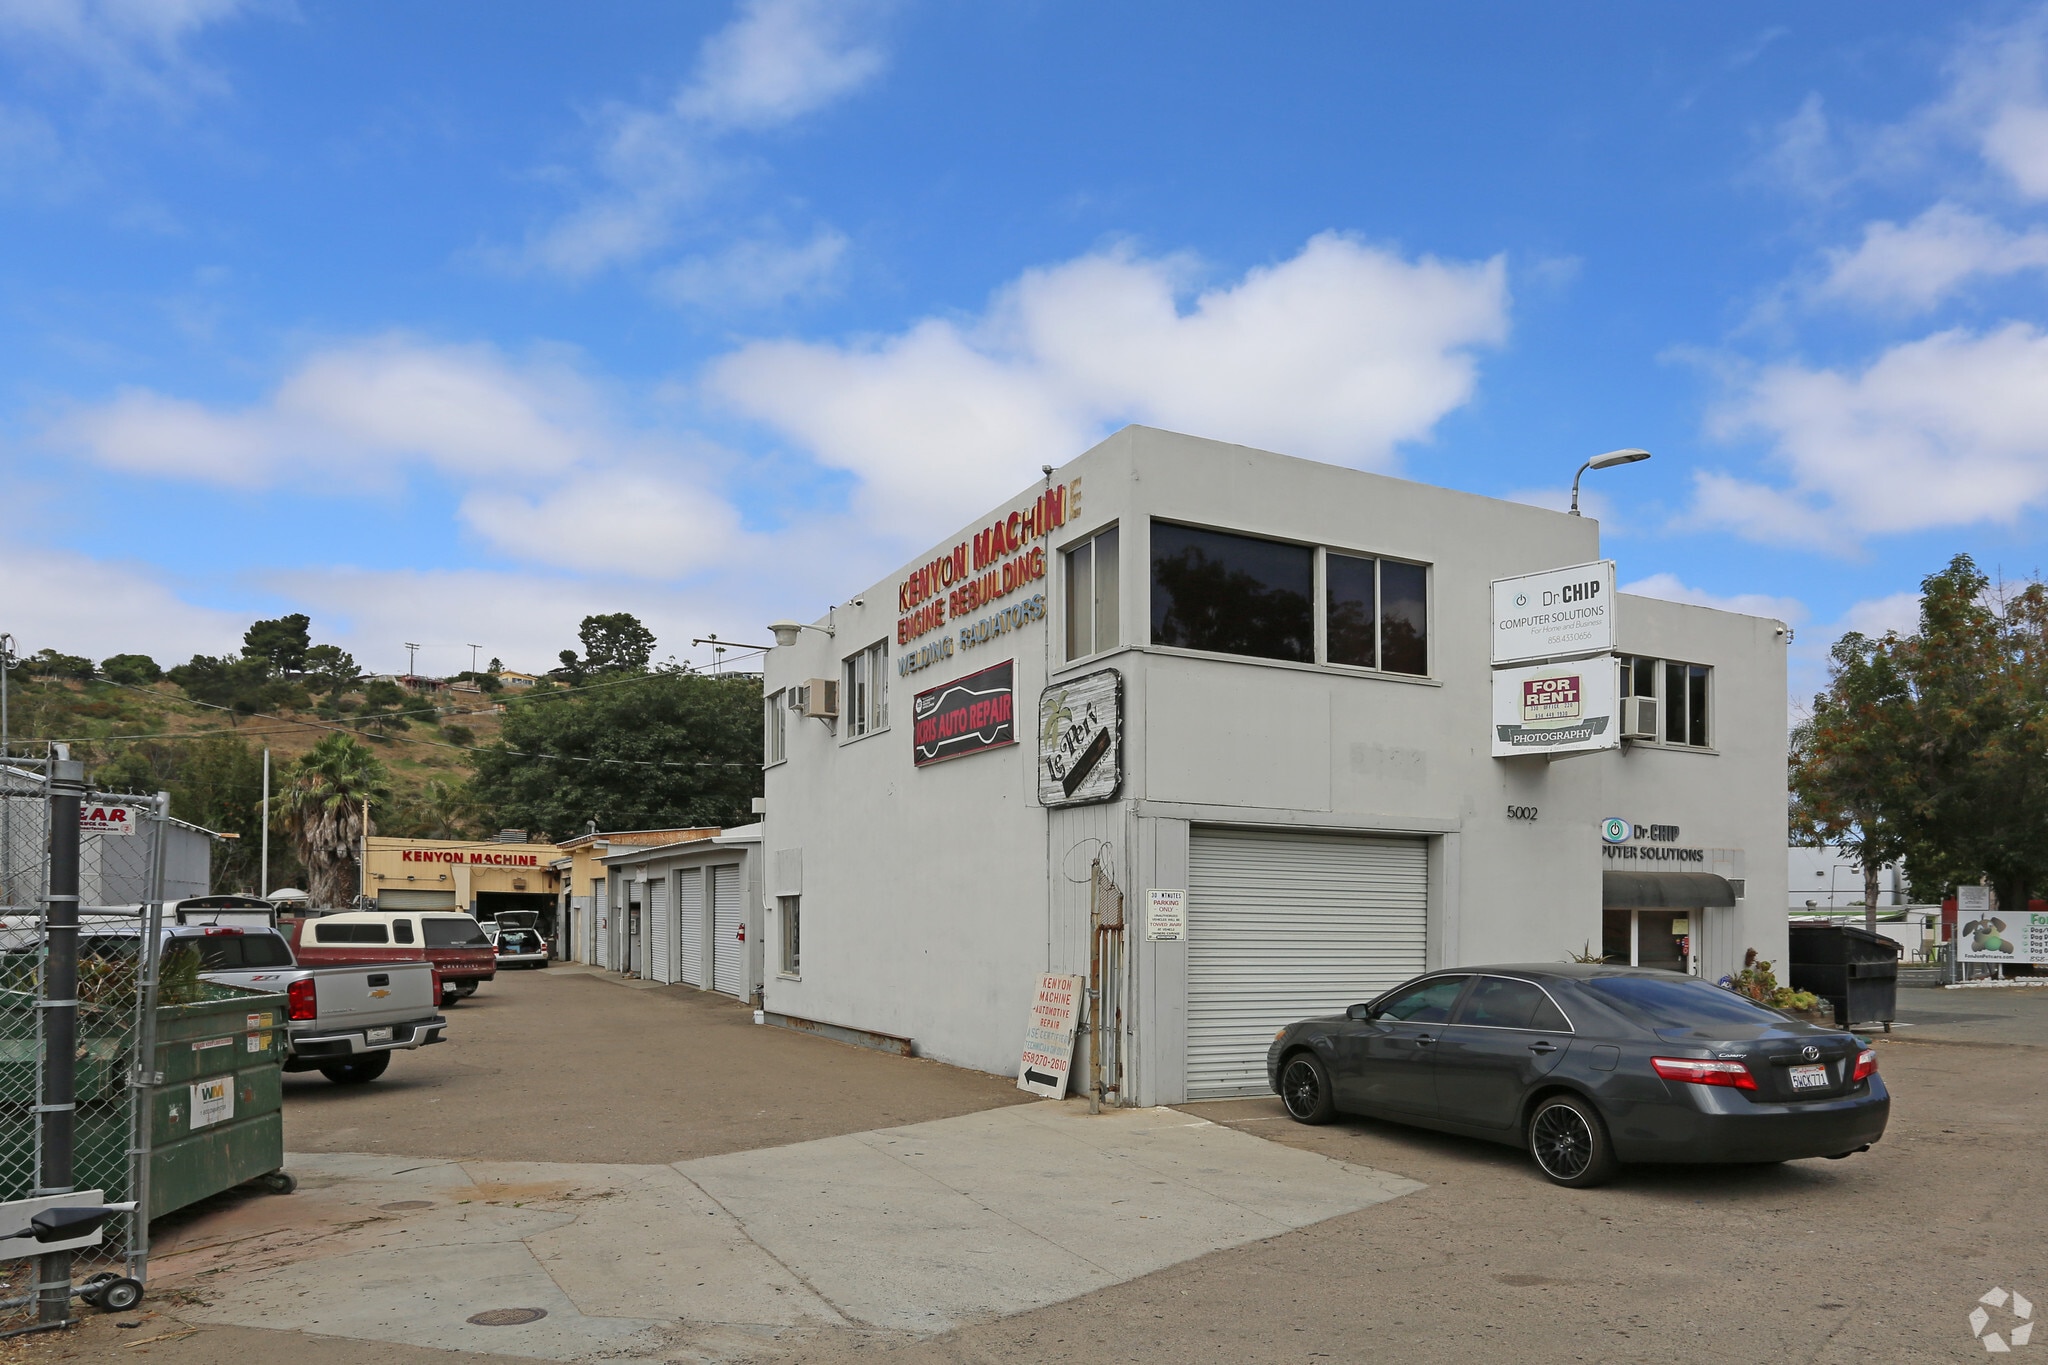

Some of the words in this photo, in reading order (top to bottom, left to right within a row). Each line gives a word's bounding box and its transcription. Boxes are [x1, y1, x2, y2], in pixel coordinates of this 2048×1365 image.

[899, 543, 969, 613] KENYON
[973, 477, 1082, 571] MACHINE
[898, 598, 946, 645] ENGINE
[949, 546, 1045, 620] REBUILDING
[1500, 614, 1550, 630] COMPUTER
[1551, 605, 1604, 623] SOLUTIONS
[1562, 621, 1575, 630] and
[1575, 619, 1602, 629] Business
[897, 635, 953, 676] WELDING
[959, 593, 1047, 650] RADIATORS
[1532, 679, 1570, 693] FOR
[1526, 690, 1577, 705] RENT
[916, 716, 937, 745] KRIS
[938, 707, 967, 739] AUTO
[969, 693, 1011, 730] REPAIR
[1513, 728, 1591, 743] PHOTOGRAPHY
[1507, 805, 1538, 821] 5002
[402, 850, 463, 863] KENYON
[470, 853, 537, 866] MACHINE
[1640, 847, 1704, 862] SOLUTIONS
[2031, 913, 2048, 925] Fo
[1043, 977, 1072, 991] KENYON
[1039, 991, 1071, 1005] MACHINE
[1040, 1018, 1060, 1029] REPAIR
[1792, 1073, 1827, 1087] 5WCK771
